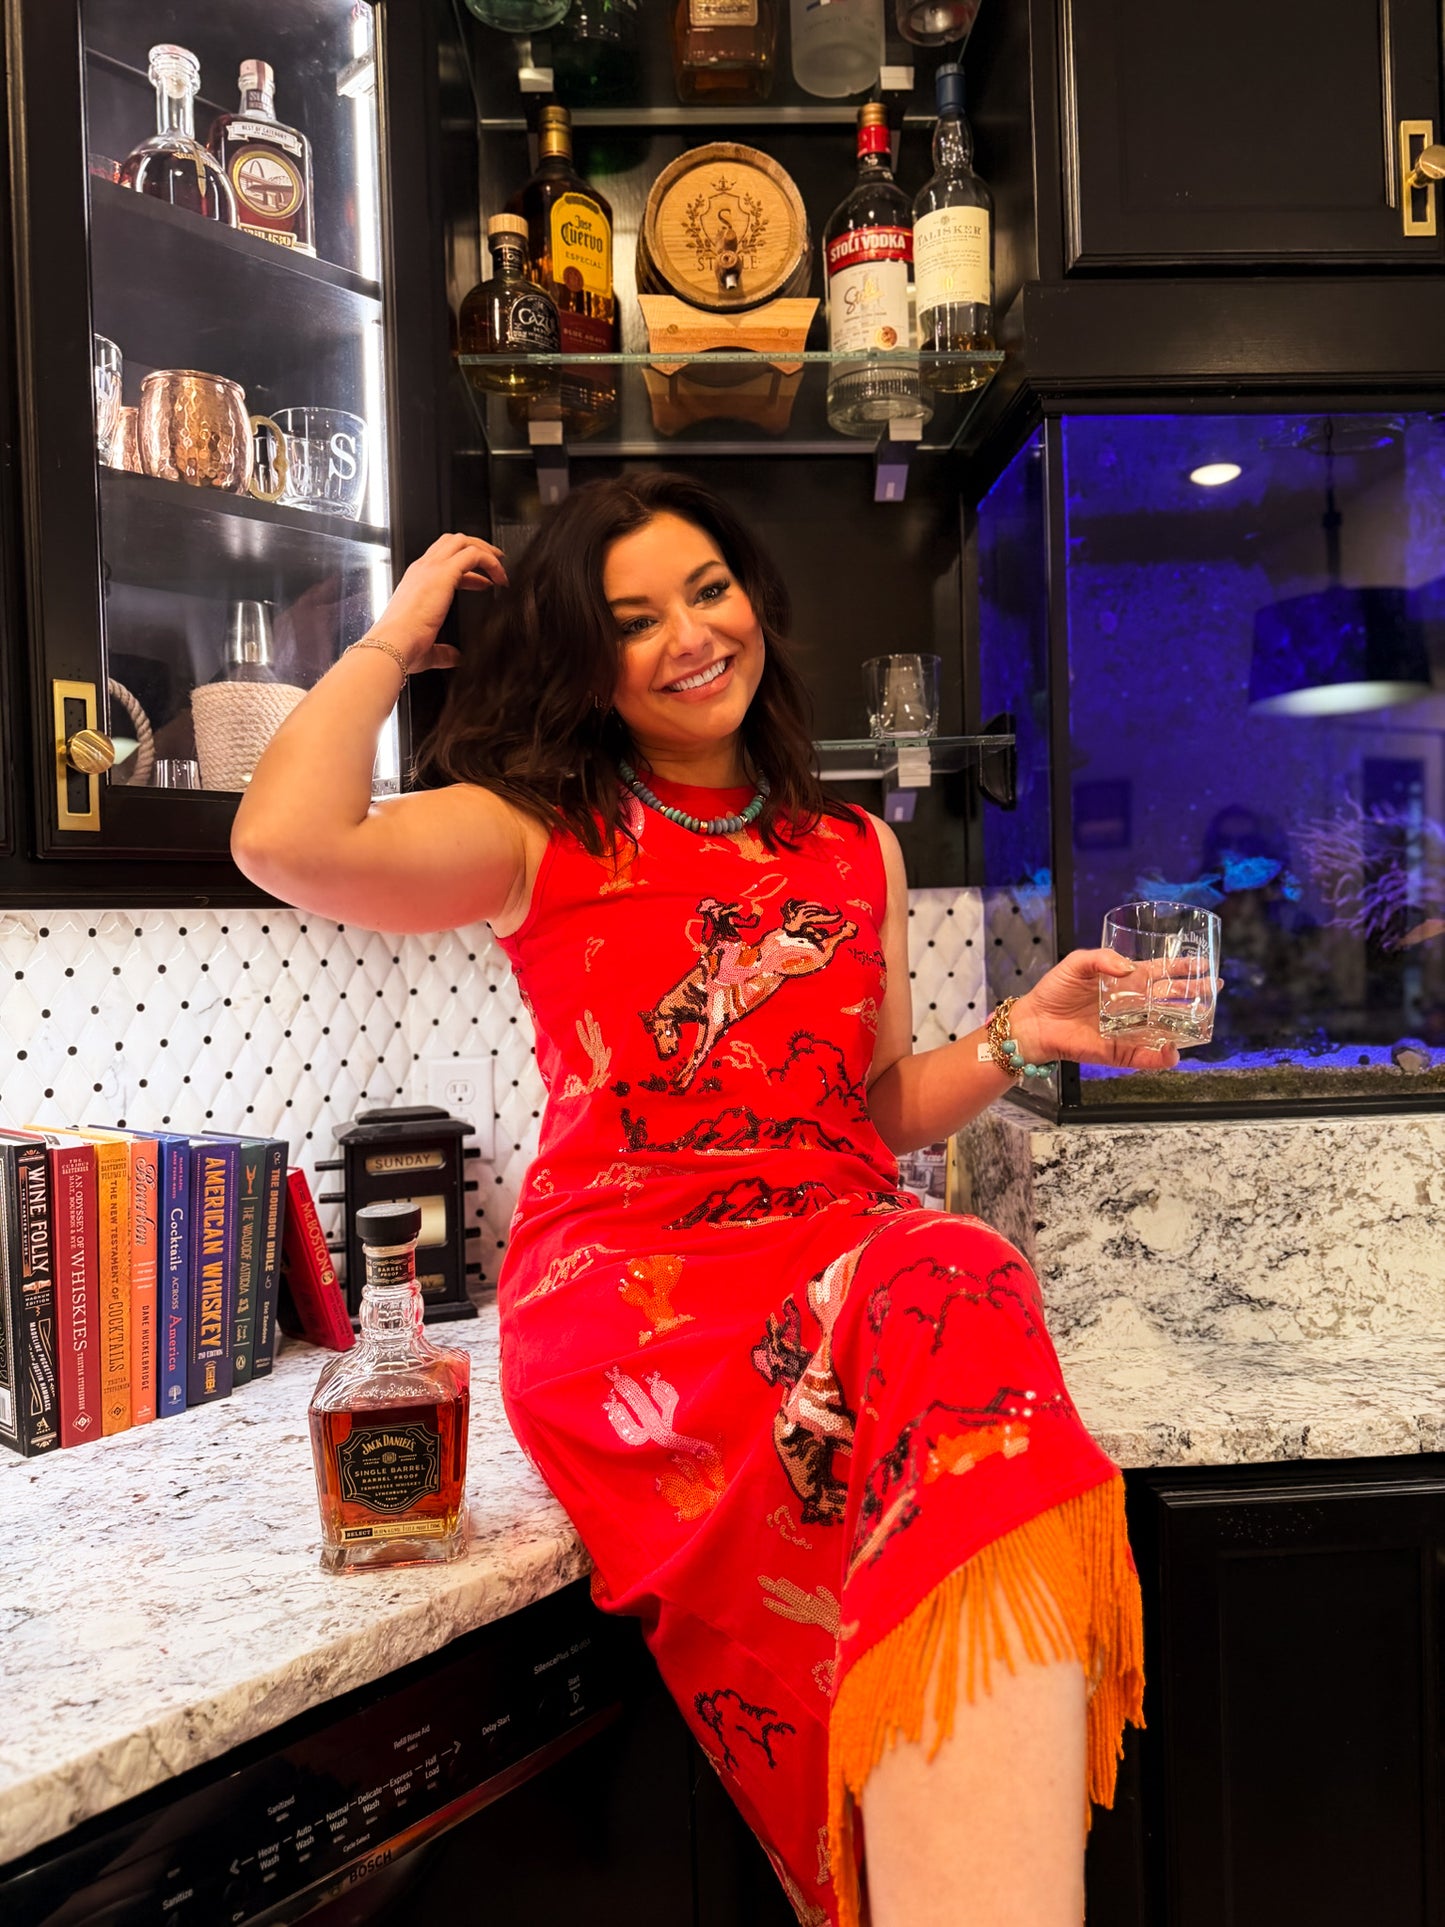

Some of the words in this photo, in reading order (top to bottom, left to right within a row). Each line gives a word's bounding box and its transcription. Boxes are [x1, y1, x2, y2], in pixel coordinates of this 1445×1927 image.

[561, 221, 603, 253] Cuervo
[575, 215, 592, 231] Jose
[917, 224, 982, 247] TALISKER
[565, 251, 602, 269] ESPECIAL
[830, 232, 860, 263] STOLI
[860, 233, 906, 251] VODKA
[329, 432, 357, 480] S
[375, 1154, 431, 1170] SUNDAY
[28, 1165, 47, 1217] WINE
[74, 1174, 83, 1189] AN
[110, 1180, 118, 1200] THE
[271, 1168, 281, 1188] THE
[76, 1191, 85, 1234] ODYSSEY
[110, 1202, 118, 1225] NEW
[135, 1156, 156, 1247] Bourbon
[202, 1157, 226, 1255] AMERICAN
[243, 1206, 255, 1221] THE
[267, 1190, 279, 1239] BOURBON
[31, 1221, 49, 1272] FOLLY
[77, 1236, 85, 1249] OF
[170, 1207, 184, 1272] Cocktails
[241, 1222, 254, 1260] WALDORF
[307, 1219, 330, 1272] BOSTON
[111, 1227, 120, 1286] TESTAMENT
[265, 1241, 276, 1272] BIBLE
[377, 1265, 402, 1273] BARREL
[112, 1287, 119, 1300] OF
[171, 1276, 179, 1311] ACROSS
[238, 1261, 252, 1296] ASTORIA
[71, 1249, 88, 1352] WHISKIES
[141, 1305, 149, 1326] DANE
[200, 1260, 224, 1347] WHISKEY
[29, 1321, 41, 1353] MADELINE
[108, 1301, 125, 1373] COCKTAILS
[168, 1314, 182, 1372] America
[31, 1361, 45, 1381] JUSTIN
[141, 1329, 150, 1391] HUCKELBRIDGE
[361, 1438, 383, 1456] JACK
[382, 1433, 417, 1453] DANIEL'S
[354, 1467, 387, 1478] SINGLE
[390, 1464, 426, 1474] BARREL
[362, 1476, 391, 1484] BARREL
[360, 1483, 394, 1491] TENNESSEE
[346, 1529, 372, 1538] SELECT
[393, 1735, 407, 1750] Refill
[406, 1730, 421, 1747] Rinse
[421, 1724, 431, 1735] Aid
[482, 1723, 497, 1736] Delay
[497, 1714, 510, 1727] Start
[257, 1842, 279, 1860] Heavy
[296, 1824, 312, 1839] Auto
[326, 1802, 349, 1822] Normal
[357, 1786, 382, 1805] Delicate
[389, 1769, 413, 1788] Express
[425, 1753, 437, 1768] Half
[260, 1854, 280, 1871] Wash
[295, 1835, 314, 1851] Wash
[329, 1817, 348, 1832] Wash
[362, 1799, 380, 1814] Wash
[394, 1782, 411, 1797] Wash
[425, 1765, 440, 1779] Load
[267, 1794, 295, 1816] Sanitized
[349, 1850, 392, 1884] BOSCH
[162, 1888, 194, 1911] Sanitize
